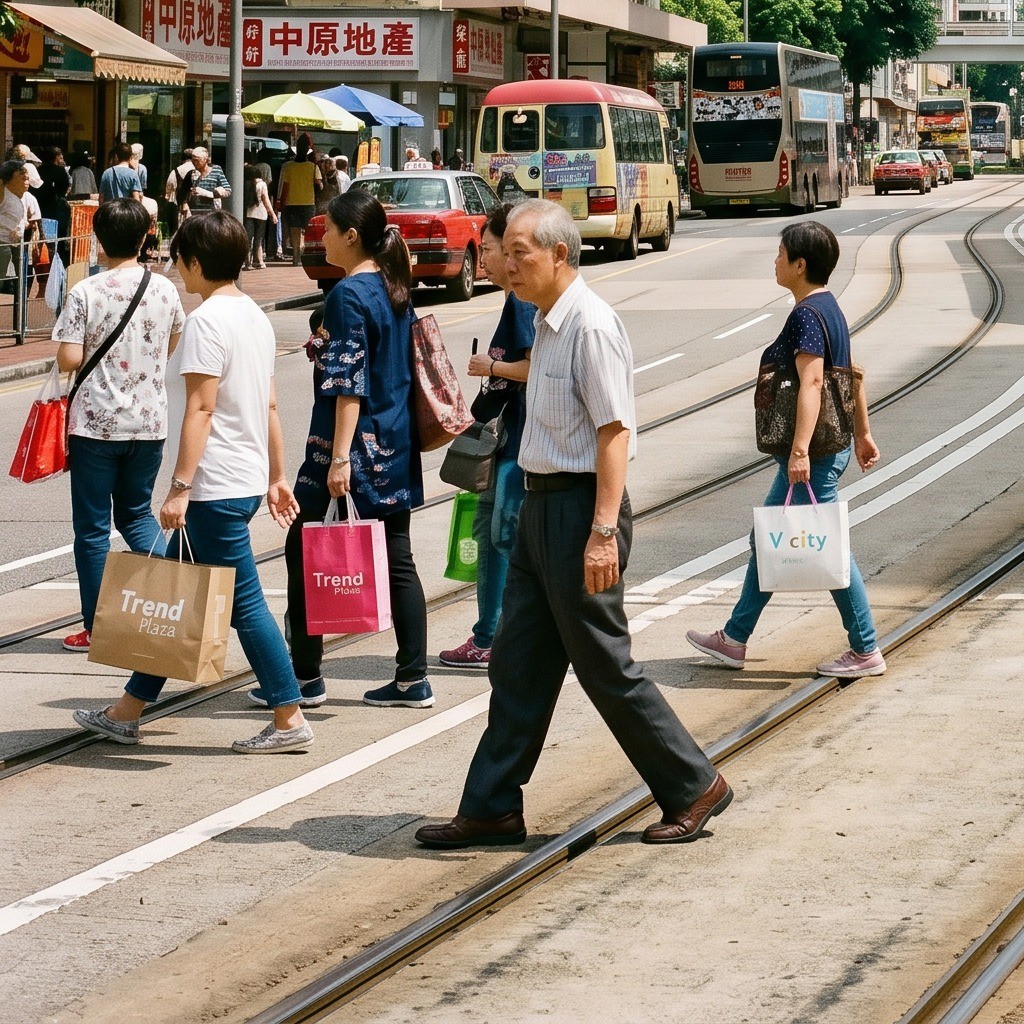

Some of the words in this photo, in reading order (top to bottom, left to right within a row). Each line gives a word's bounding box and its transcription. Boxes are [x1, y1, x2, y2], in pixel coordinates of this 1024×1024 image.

[269, 21, 414, 57] 中原地產
[789, 529, 827, 552] city
[313, 571, 364, 588] Trend
[120, 589, 186, 622] Trend
[138, 617, 176, 638] Plaza
